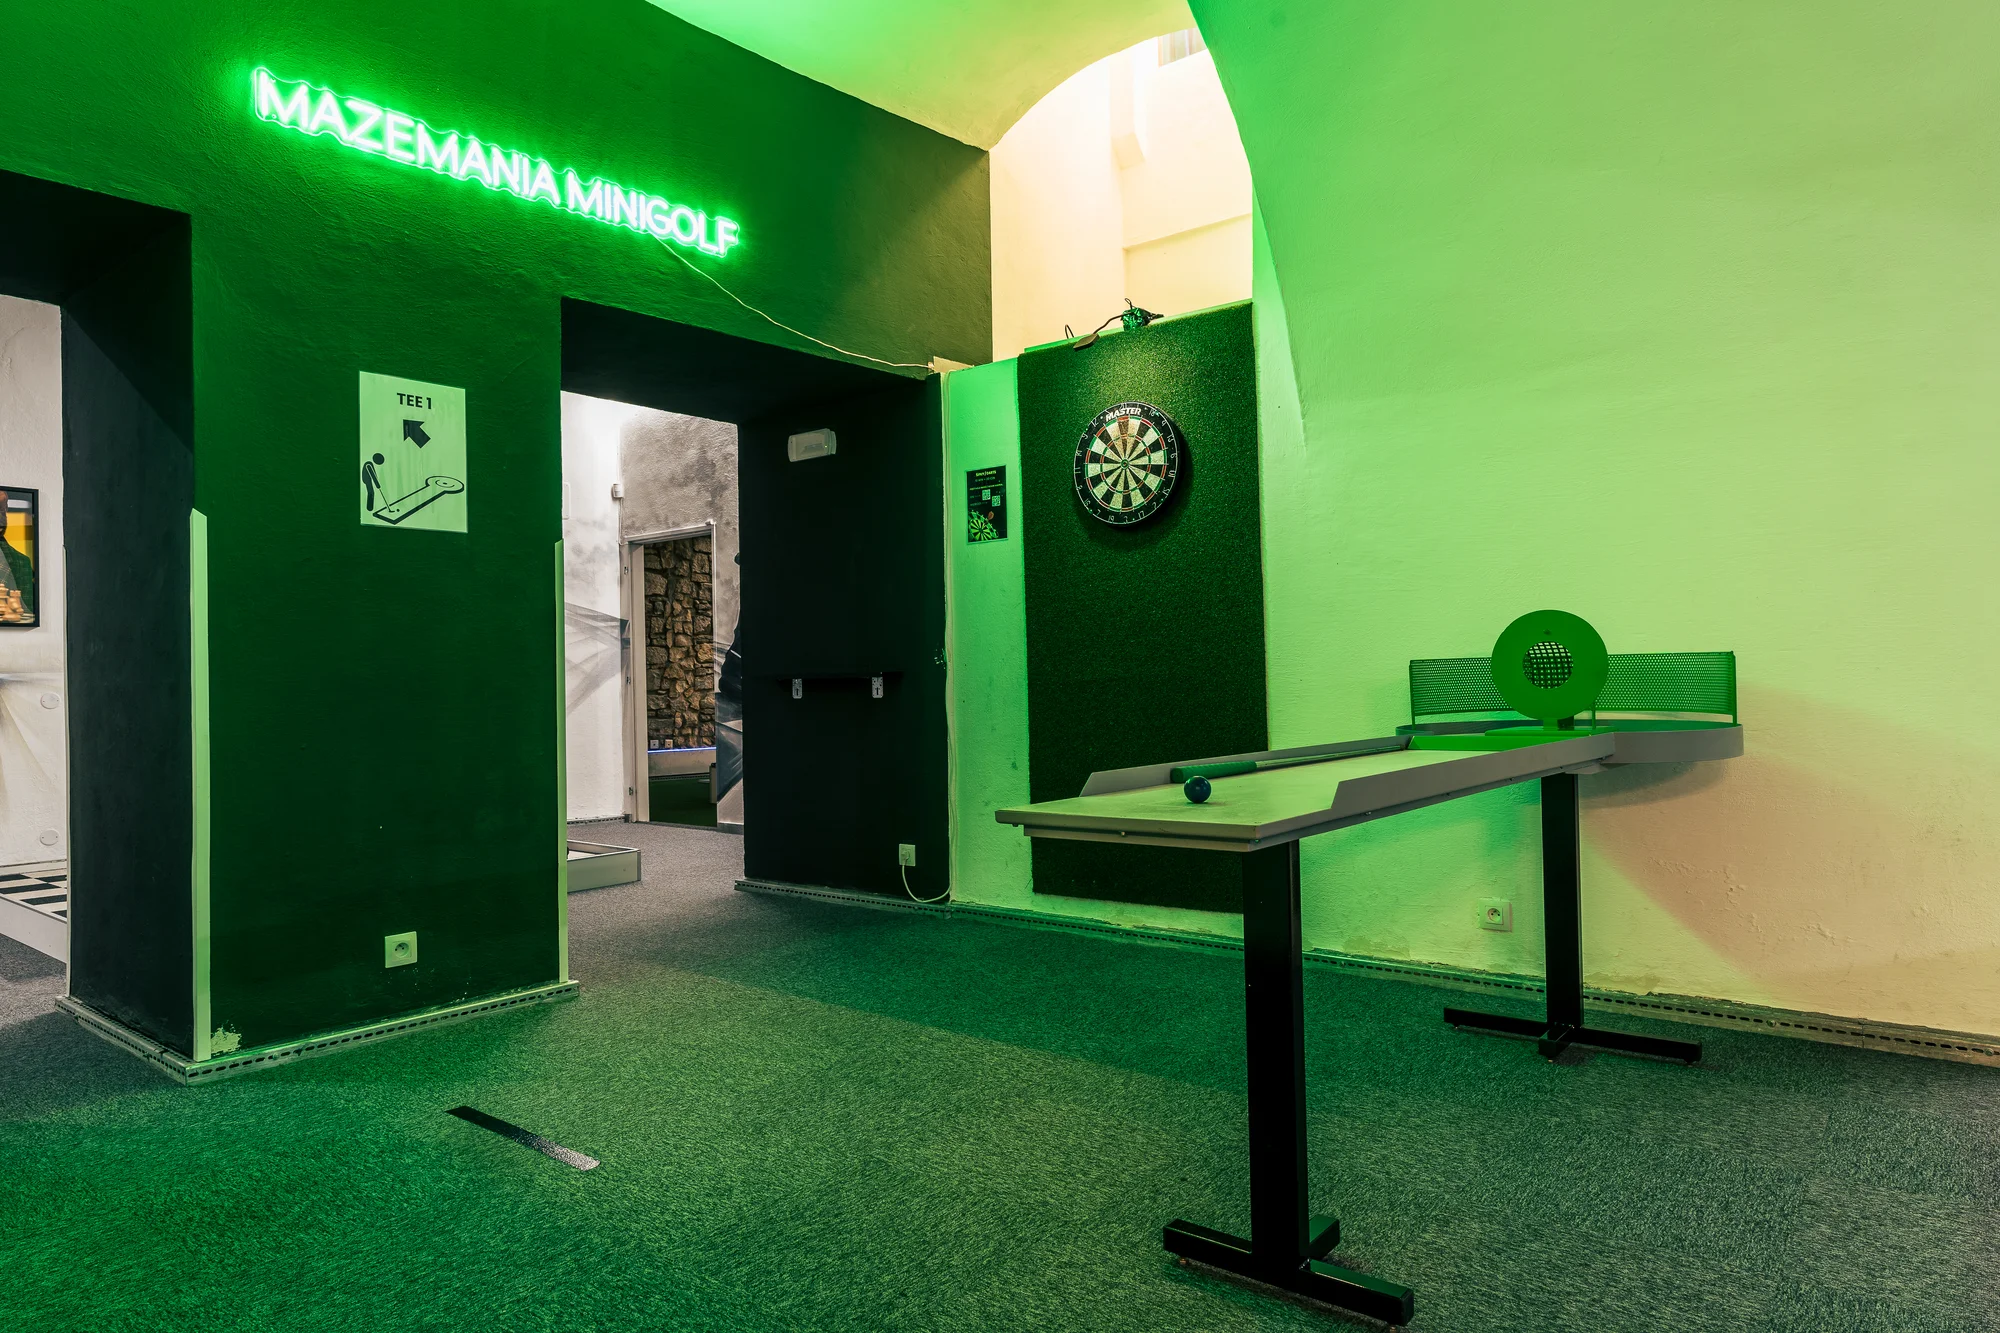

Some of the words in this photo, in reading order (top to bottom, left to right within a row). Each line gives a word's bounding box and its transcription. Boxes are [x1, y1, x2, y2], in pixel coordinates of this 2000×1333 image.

[257, 69, 561, 206] MAZEMANIA
[566, 171, 739, 256] MINIGOLF
[396, 392, 423, 409] TEE
[426, 397, 432, 410] 1
[1105, 407, 1142, 421] MASTER
[1138, 511, 1145, 519] 17
